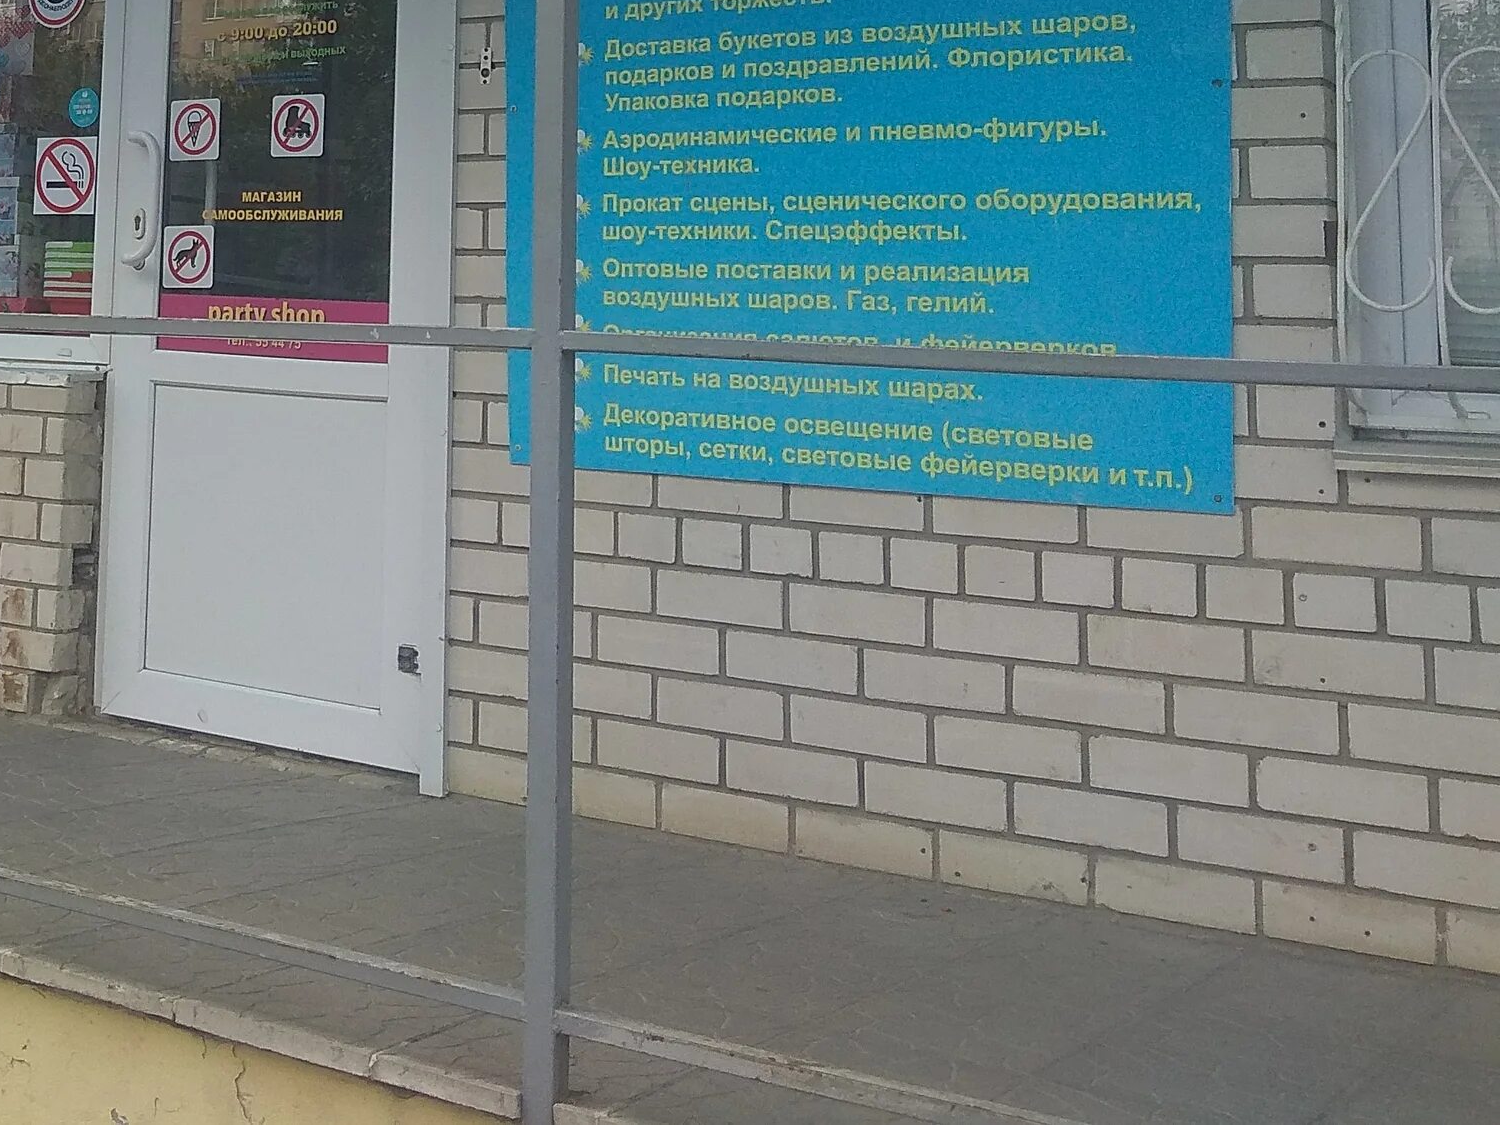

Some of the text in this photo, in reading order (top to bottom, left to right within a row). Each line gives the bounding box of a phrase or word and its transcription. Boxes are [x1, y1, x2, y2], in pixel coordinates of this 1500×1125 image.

[605, 4, 619, 20] и
[231, 20, 338, 41] 9:00 до 20:00
[605, 13, 1138, 62] Доставка букетов из воздушных шаров,
[605, 45, 1133, 87] подарков и поздравлений. Флористика.
[605, 86, 843, 112] Упаковка подарков.
[602, 117, 1108, 152] Аэродинамические и пневмо-фигуры.
[602, 156, 760, 180] Шоу-техника.
[241, 191, 302, 203] МАГАЗИН
[602, 188, 1202, 217] Прокат сцены, сценического оборудования,
[202, 209, 343, 222] САМООБСЛУЖИВАНИЯ
[602, 219, 968, 246] шоу-техники. Спецэффекты.
[602, 257, 1031, 286] Оптовые поставки и реализация
[602, 289, 995, 315] воздушных шаров. Газ, гелий.
[602, 364, 985, 403] Печать на воздушных шарах.
[602, 403, 1094, 452] Декоративное освещение (световые
[605, 433, 1193, 495] шторы, сетки, световые фейерверки и т.п.)
